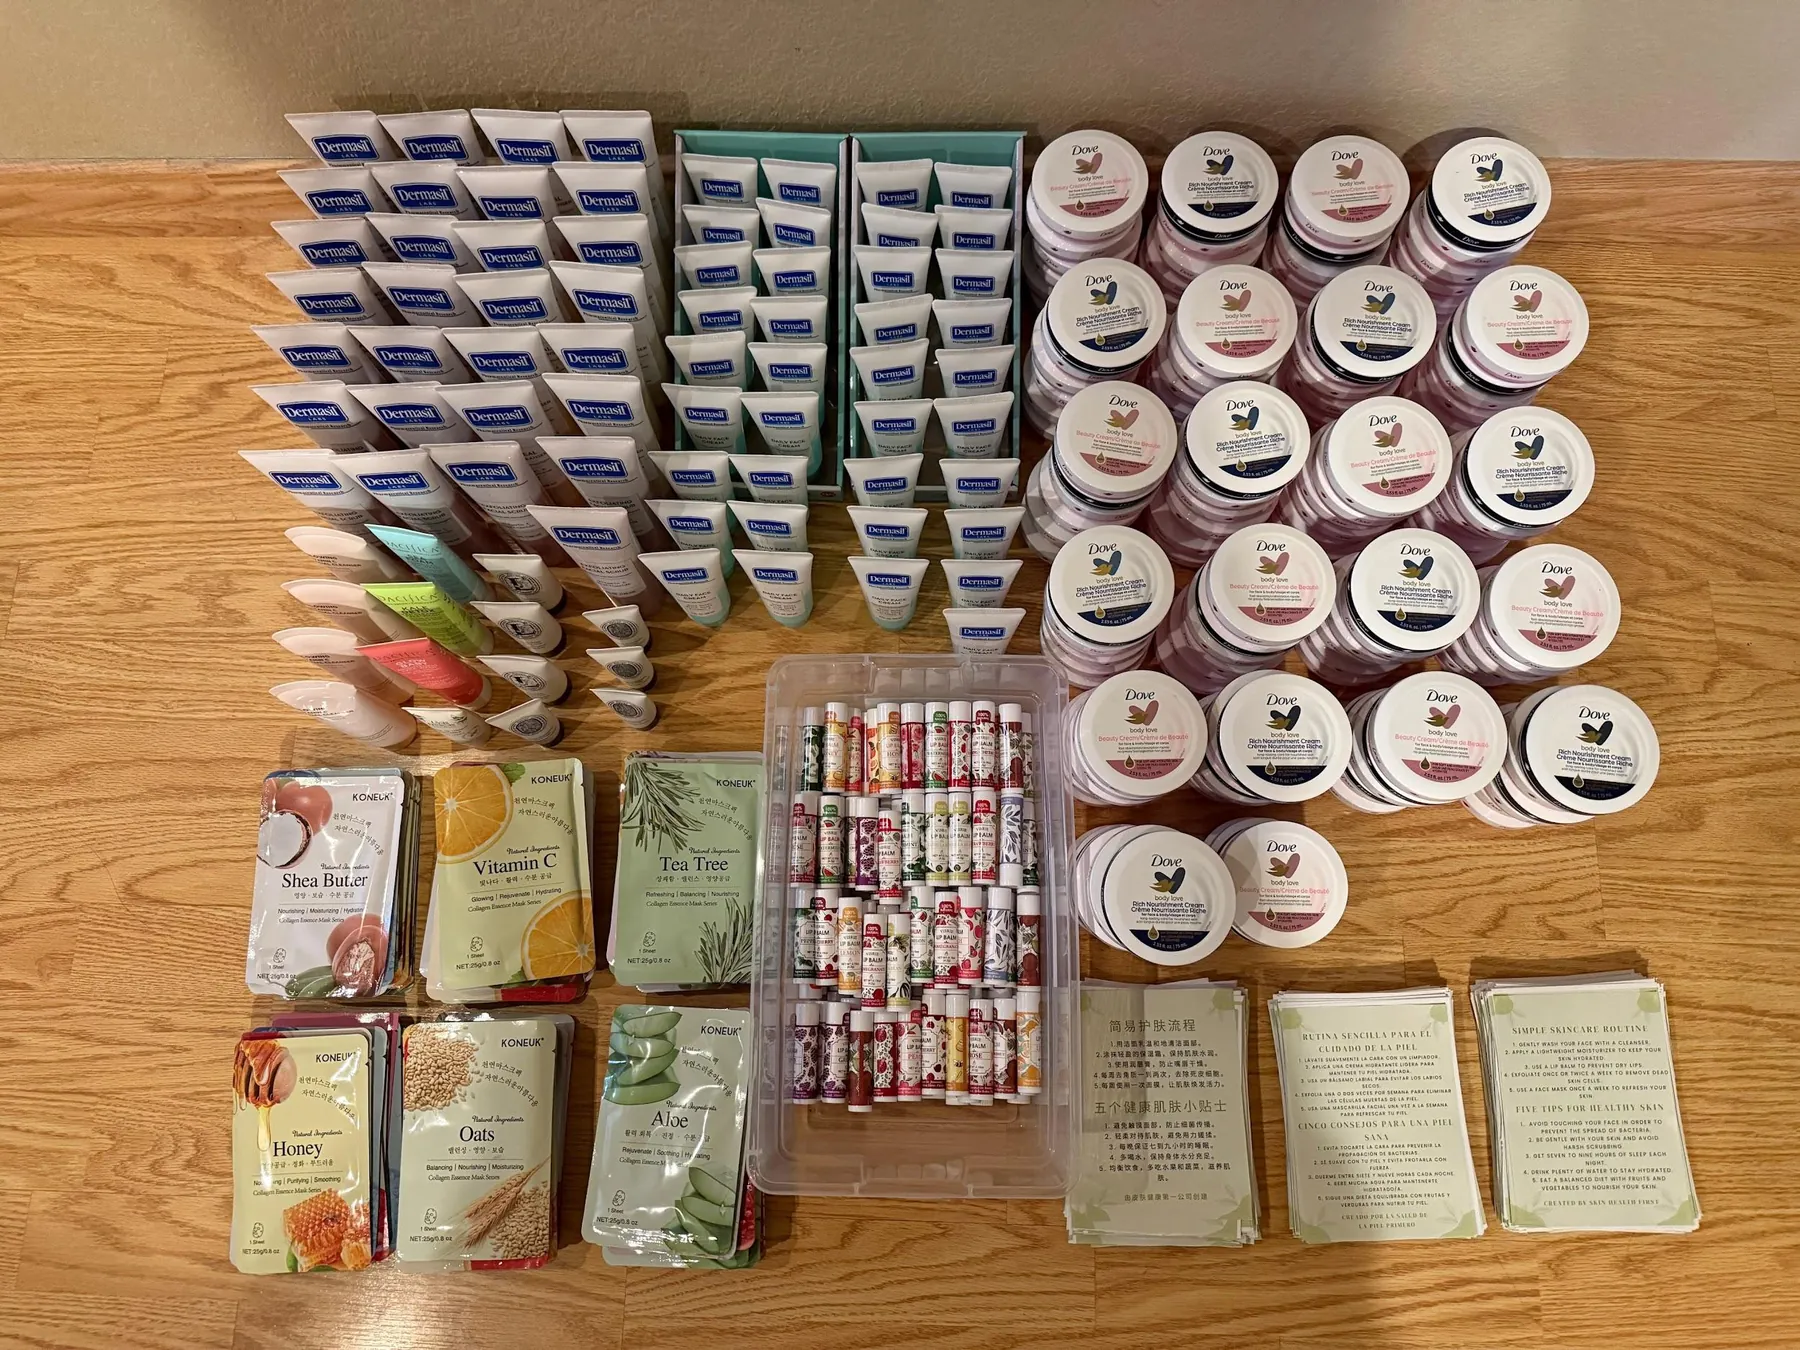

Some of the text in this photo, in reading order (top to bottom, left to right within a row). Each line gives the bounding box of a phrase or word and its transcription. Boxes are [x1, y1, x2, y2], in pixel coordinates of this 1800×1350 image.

[318, 138, 374, 154] Dermasil
[500, 144, 556, 157] Dermasil
[588, 142, 643, 157] Dermasil
[1072, 144, 1099, 156] Dove
[1203, 146, 1230, 156] Dove
[1332, 150, 1359, 161] Dove
[1471, 151, 1497, 165] Dove
[703, 182, 741, 194] Dermasil
[311, 192, 365, 209] Dermasil
[396, 187, 451, 203] Dermasil
[583, 193, 636, 209] Dermasil
[776, 226, 813, 239] Dermasil
[482, 249, 538, 264] Dermasil
[583, 245, 638, 258] Dermasil
[874, 274, 912, 284] Dermasil
[1085, 273, 1113, 286] Dove
[1220, 280, 1247, 291] Dove
[1510, 280, 1538, 291] Dove
[1364, 280, 1393, 293] Dove
[300, 296, 357, 311] Dermasil
[392, 291, 448, 307] Dermasil
[578, 292, 633, 308] Dermasil
[772, 321, 809, 332] Dermasil
[286, 349, 343, 364] Dermasil
[473, 355, 530, 369] Dermasil
[957, 372, 993, 382] Dermasil
[1109, 394, 1138, 408] Dove
[1226, 399, 1254, 412] Dove
[282, 405, 341, 420] Dermasil
[381, 406, 437, 422] Dermasil
[571, 402, 627, 418] Dermasil
[687, 409, 726, 420] Dermasil
[1369, 414, 1397, 427] Dove
[1511, 425, 1540, 438] Dove
[453, 465, 511, 481] Dermasil
[565, 460, 622, 476] Dermasil
[275, 475, 335, 489] Dermasil
[363, 475, 423, 490] Dermasil
[672, 471, 713, 482] Dermasil
[959, 479, 998, 489] Dermasil
[557, 529, 616, 545] Dermasil
[1088, 542, 1116, 555] Dove
[1256, 540, 1286, 552] Dove
[1401, 543, 1430, 557] Dove
[1542, 561, 1572, 575] Dove
[756, 569, 796, 581] Dermasil
[961, 578, 999, 588] Dermasil
[964, 628, 1002, 638] Dermasil
[1125, 688, 1155, 701] Dove
[1266, 694, 1297, 706] Dove
[1426, 688, 1458, 703] Dove
[1578, 705, 1610, 720] Dove
[532, 774, 570, 784] KONEUK
[716, 779, 753, 788] KONEUK
[1266, 840, 1296, 853] Dove
[473, 853, 557, 875] Vitamin C
[660, 857, 728, 871] Tea Tree
[1151, 854, 1182, 867] Dove
[282, 874, 318, 887] Shea
[701, 1025, 738, 1036] KONEUK
[1109, 1019, 1196, 1033] 简易护肤流程
[1604, 1025, 1648, 1033] ROUTINE
[502, 1039, 541, 1047] KONEUK
[1303, 1033, 1338, 1041] RUTINA
[1319, 1045, 1361, 1053] CUIDADO
[1095, 1100, 1227, 1114] 五个健康肌肤小贴士
[1516, 1105, 1537, 1113] FIVE
[1567, 1104, 1586, 1112] FOR
[1640, 1103, 1664, 1111] SKIN
[651, 1111, 688, 1128] Aloe
[1382, 1120, 1406, 1128] PARA
[1433, 1118, 1453, 1126] PIEL
[460, 1126, 494, 1142] Oats
[1365, 1133, 1389, 1141] SANA
[273, 1141, 323, 1159] Honey
[622, 1147, 652, 1156] Rejuvenate
